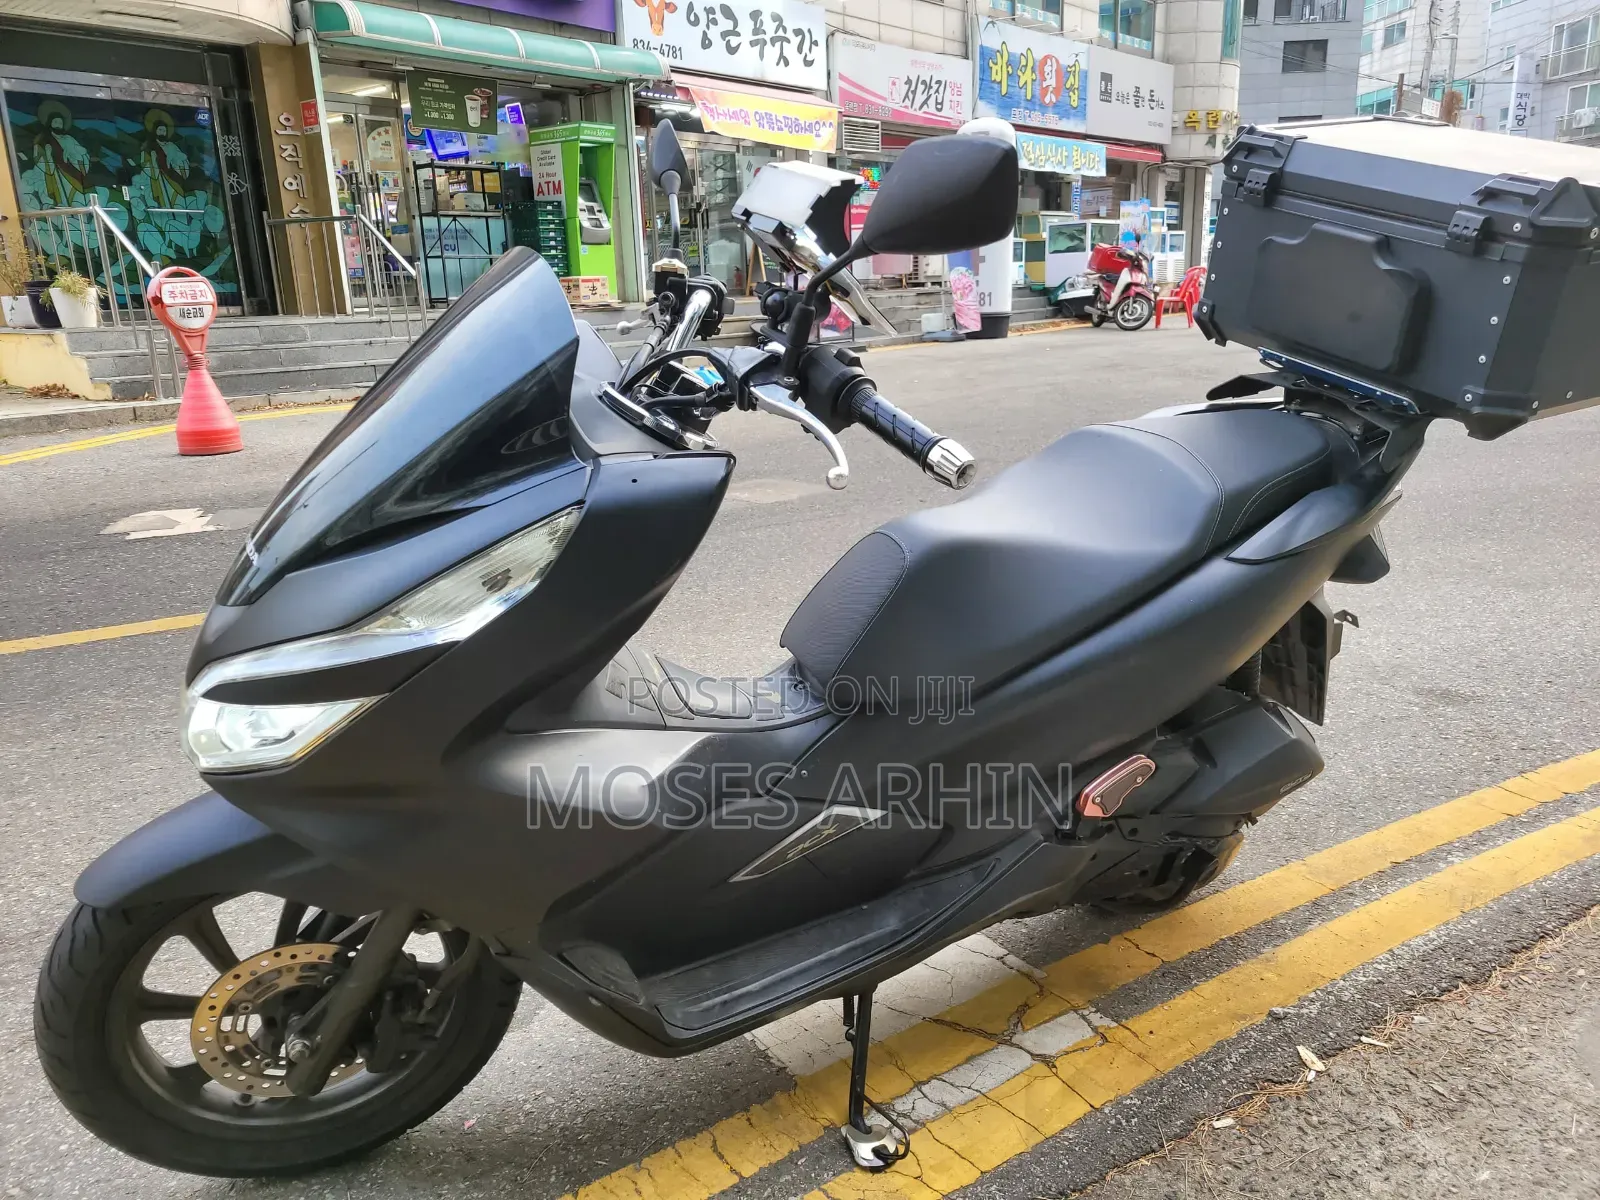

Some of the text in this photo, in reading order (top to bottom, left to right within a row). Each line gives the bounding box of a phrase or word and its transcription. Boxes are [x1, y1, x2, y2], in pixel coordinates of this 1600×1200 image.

[632, 38, 682, 60] 834-4781
[902, 74, 947, 112] 처갓집
[1515, 102, 1528, 127] 식당
[1022, 141, 1100, 171] 점심식사 됩니다
[275, 112, 312, 228] 오직예수
[536, 180, 562, 197] ATM
[443, 243, 456, 252] CU
[168, 289, 208, 301] 주차금지
[977, 292, 992, 307] 81
